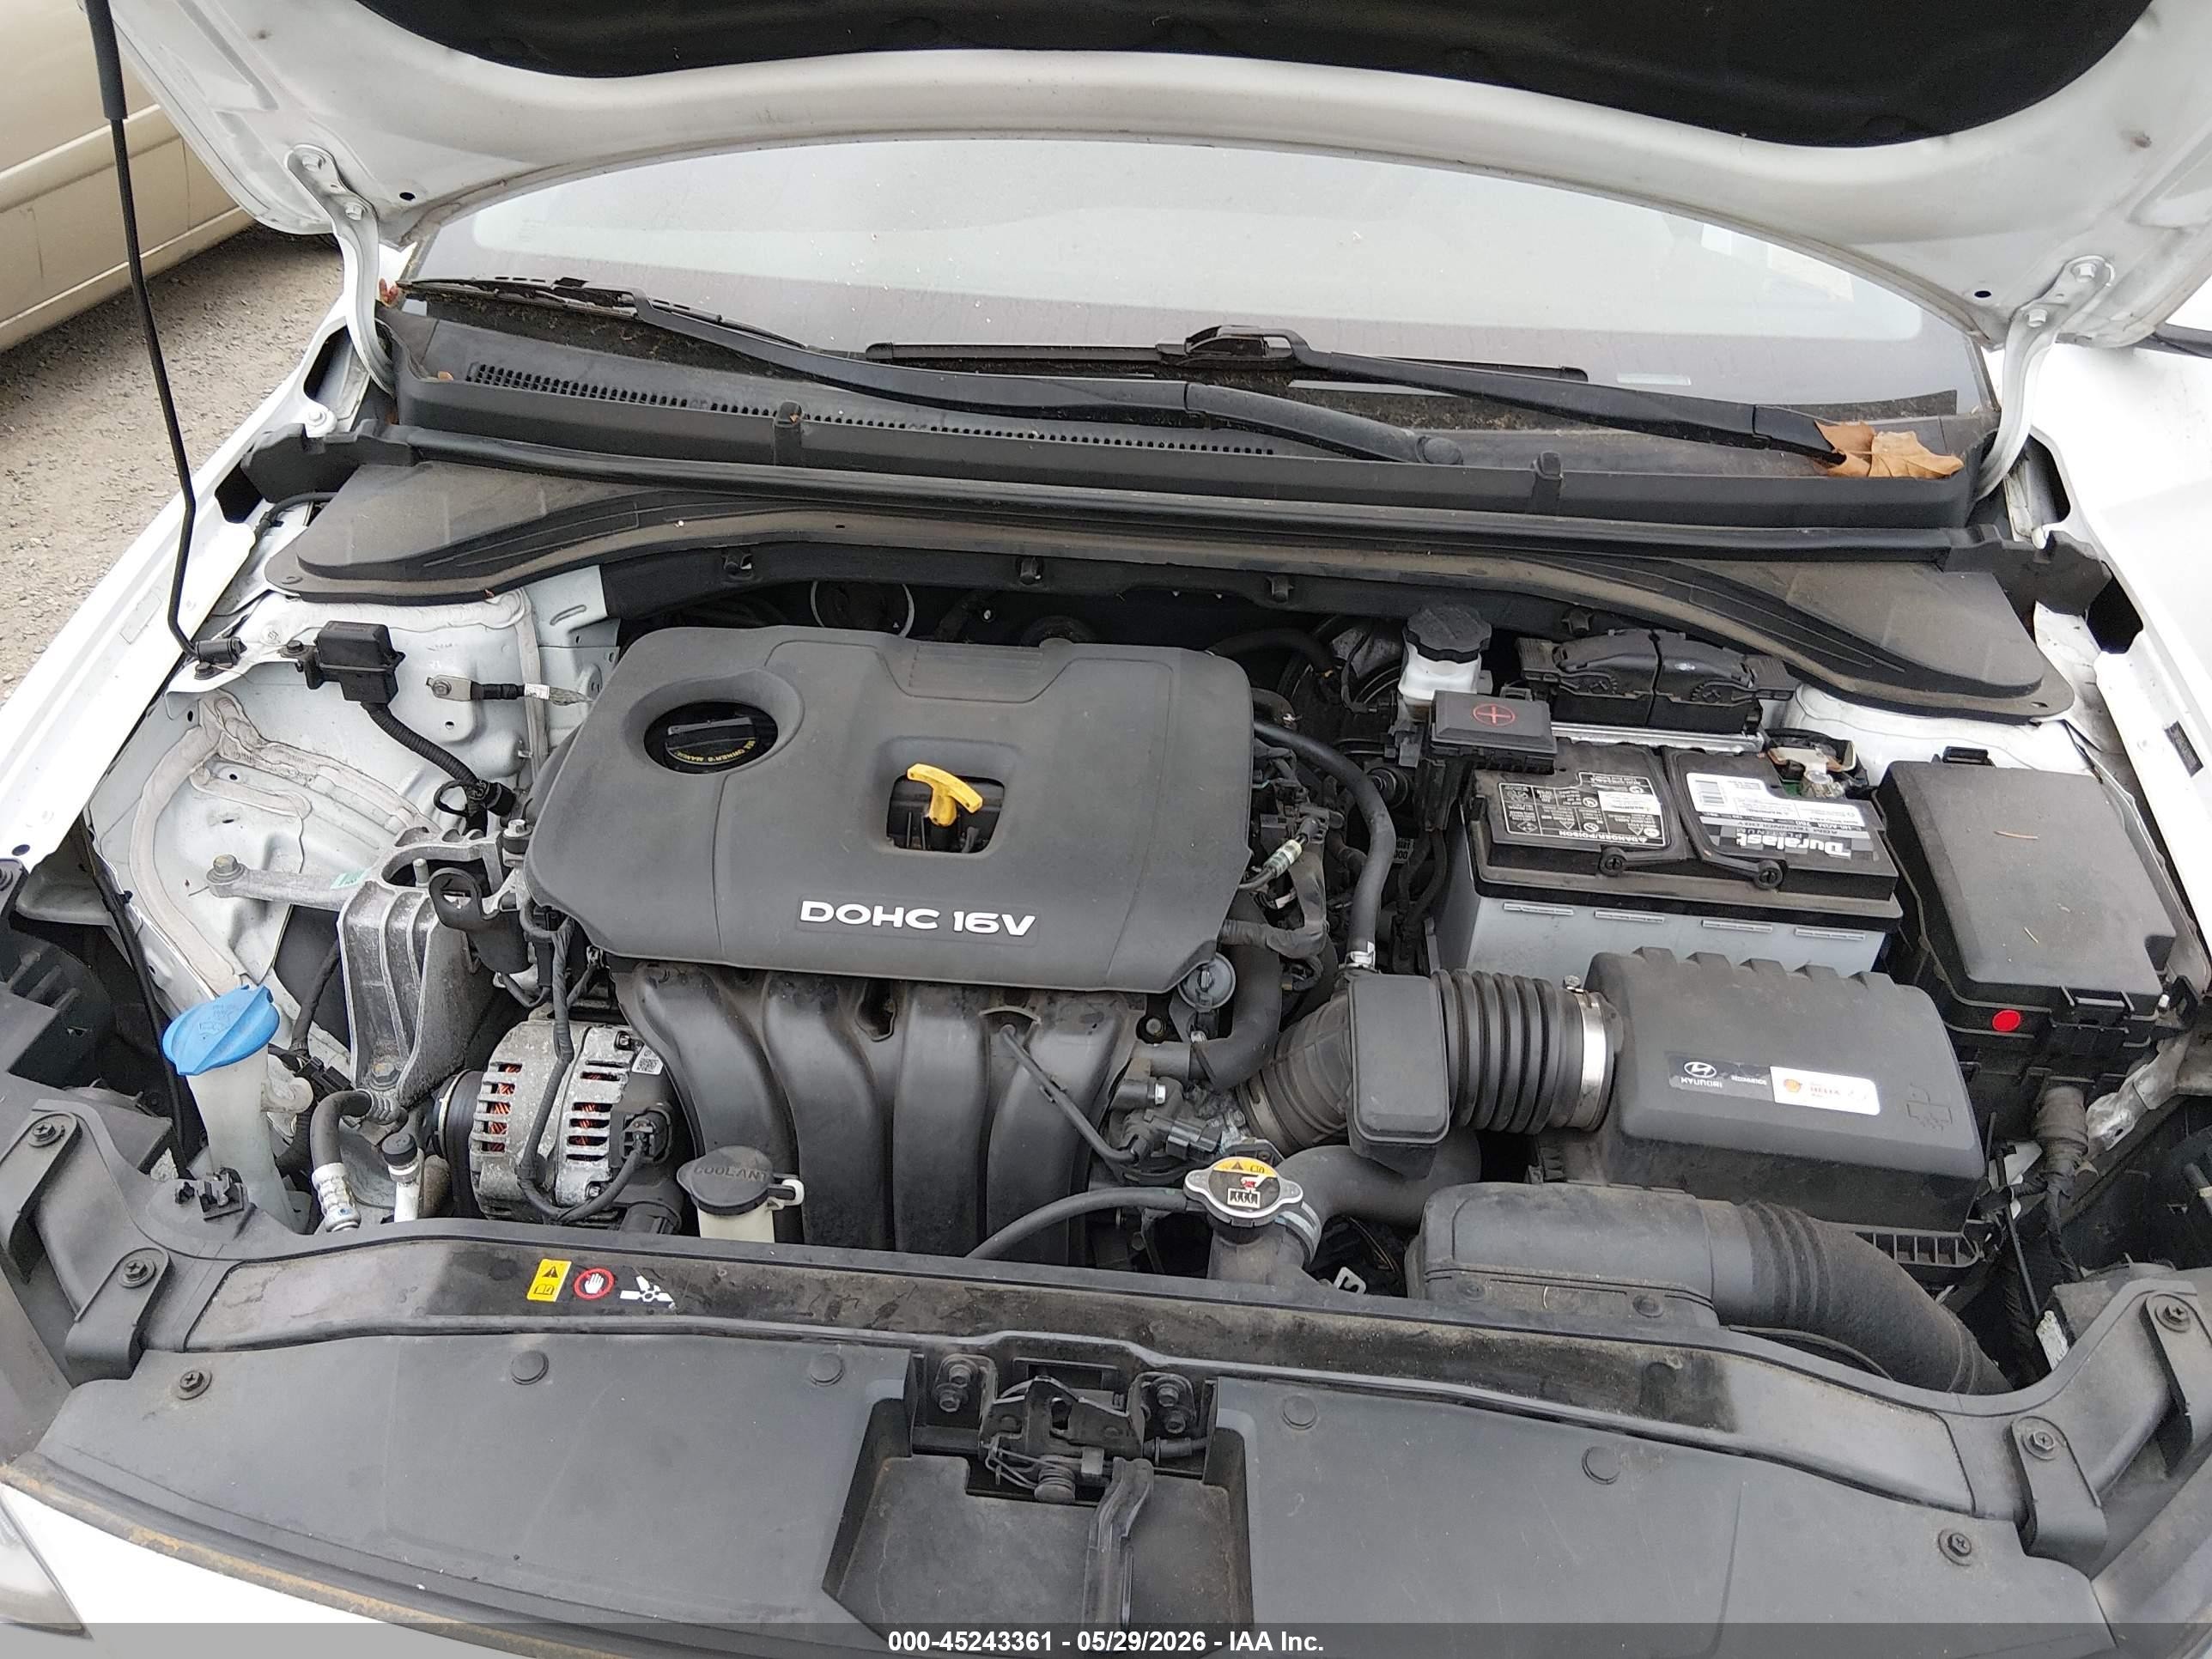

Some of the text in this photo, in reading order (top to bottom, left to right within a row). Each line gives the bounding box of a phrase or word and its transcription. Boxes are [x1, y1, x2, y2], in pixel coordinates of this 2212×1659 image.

[1736, 828, 1803, 839] PLATINUM
[1735, 832, 1851, 860] Duralast
[799, 900, 1036, 937] DOHC 16V
[1680, 1077, 1723, 1089] HYUNDAI
[693, 1166, 769, 1182] COOLANT
